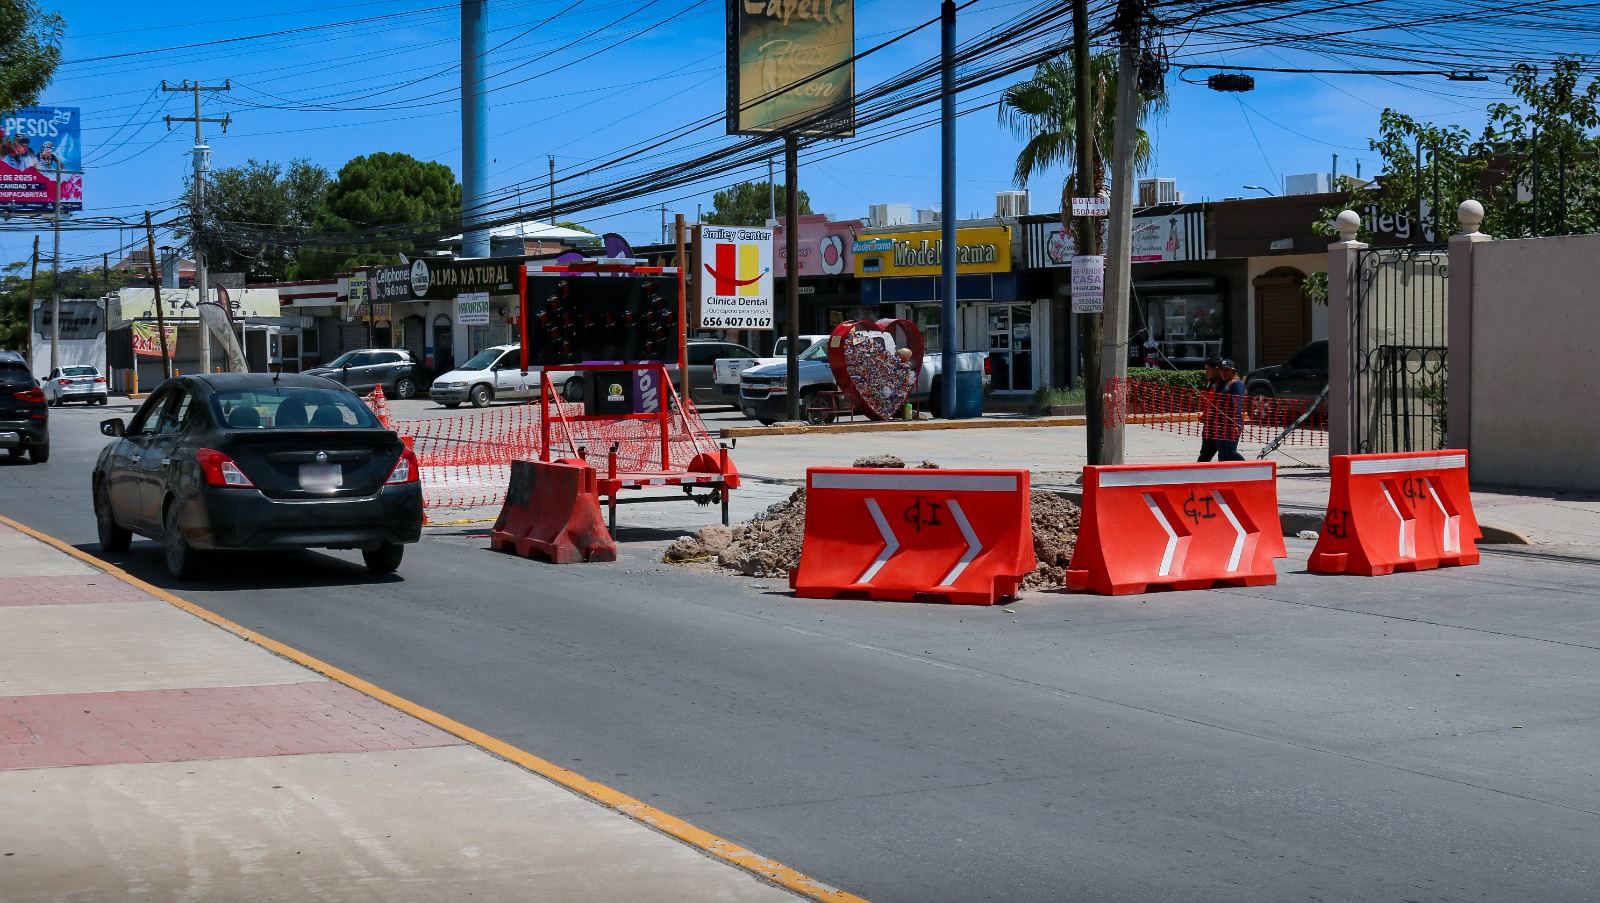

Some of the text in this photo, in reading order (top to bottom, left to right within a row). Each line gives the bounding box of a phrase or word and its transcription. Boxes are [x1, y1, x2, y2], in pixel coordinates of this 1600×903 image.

[5, 118, 58, 137] PESOS
[703, 228, 771, 242] Smiley Center
[429, 268, 458, 287] ALMA
[460, 265, 509, 285] NATURAL
[1072, 275, 1102, 284] CASA
[707, 297, 768, 306] Clínica Dental
[703, 317, 771, 327] 656 407 0167
